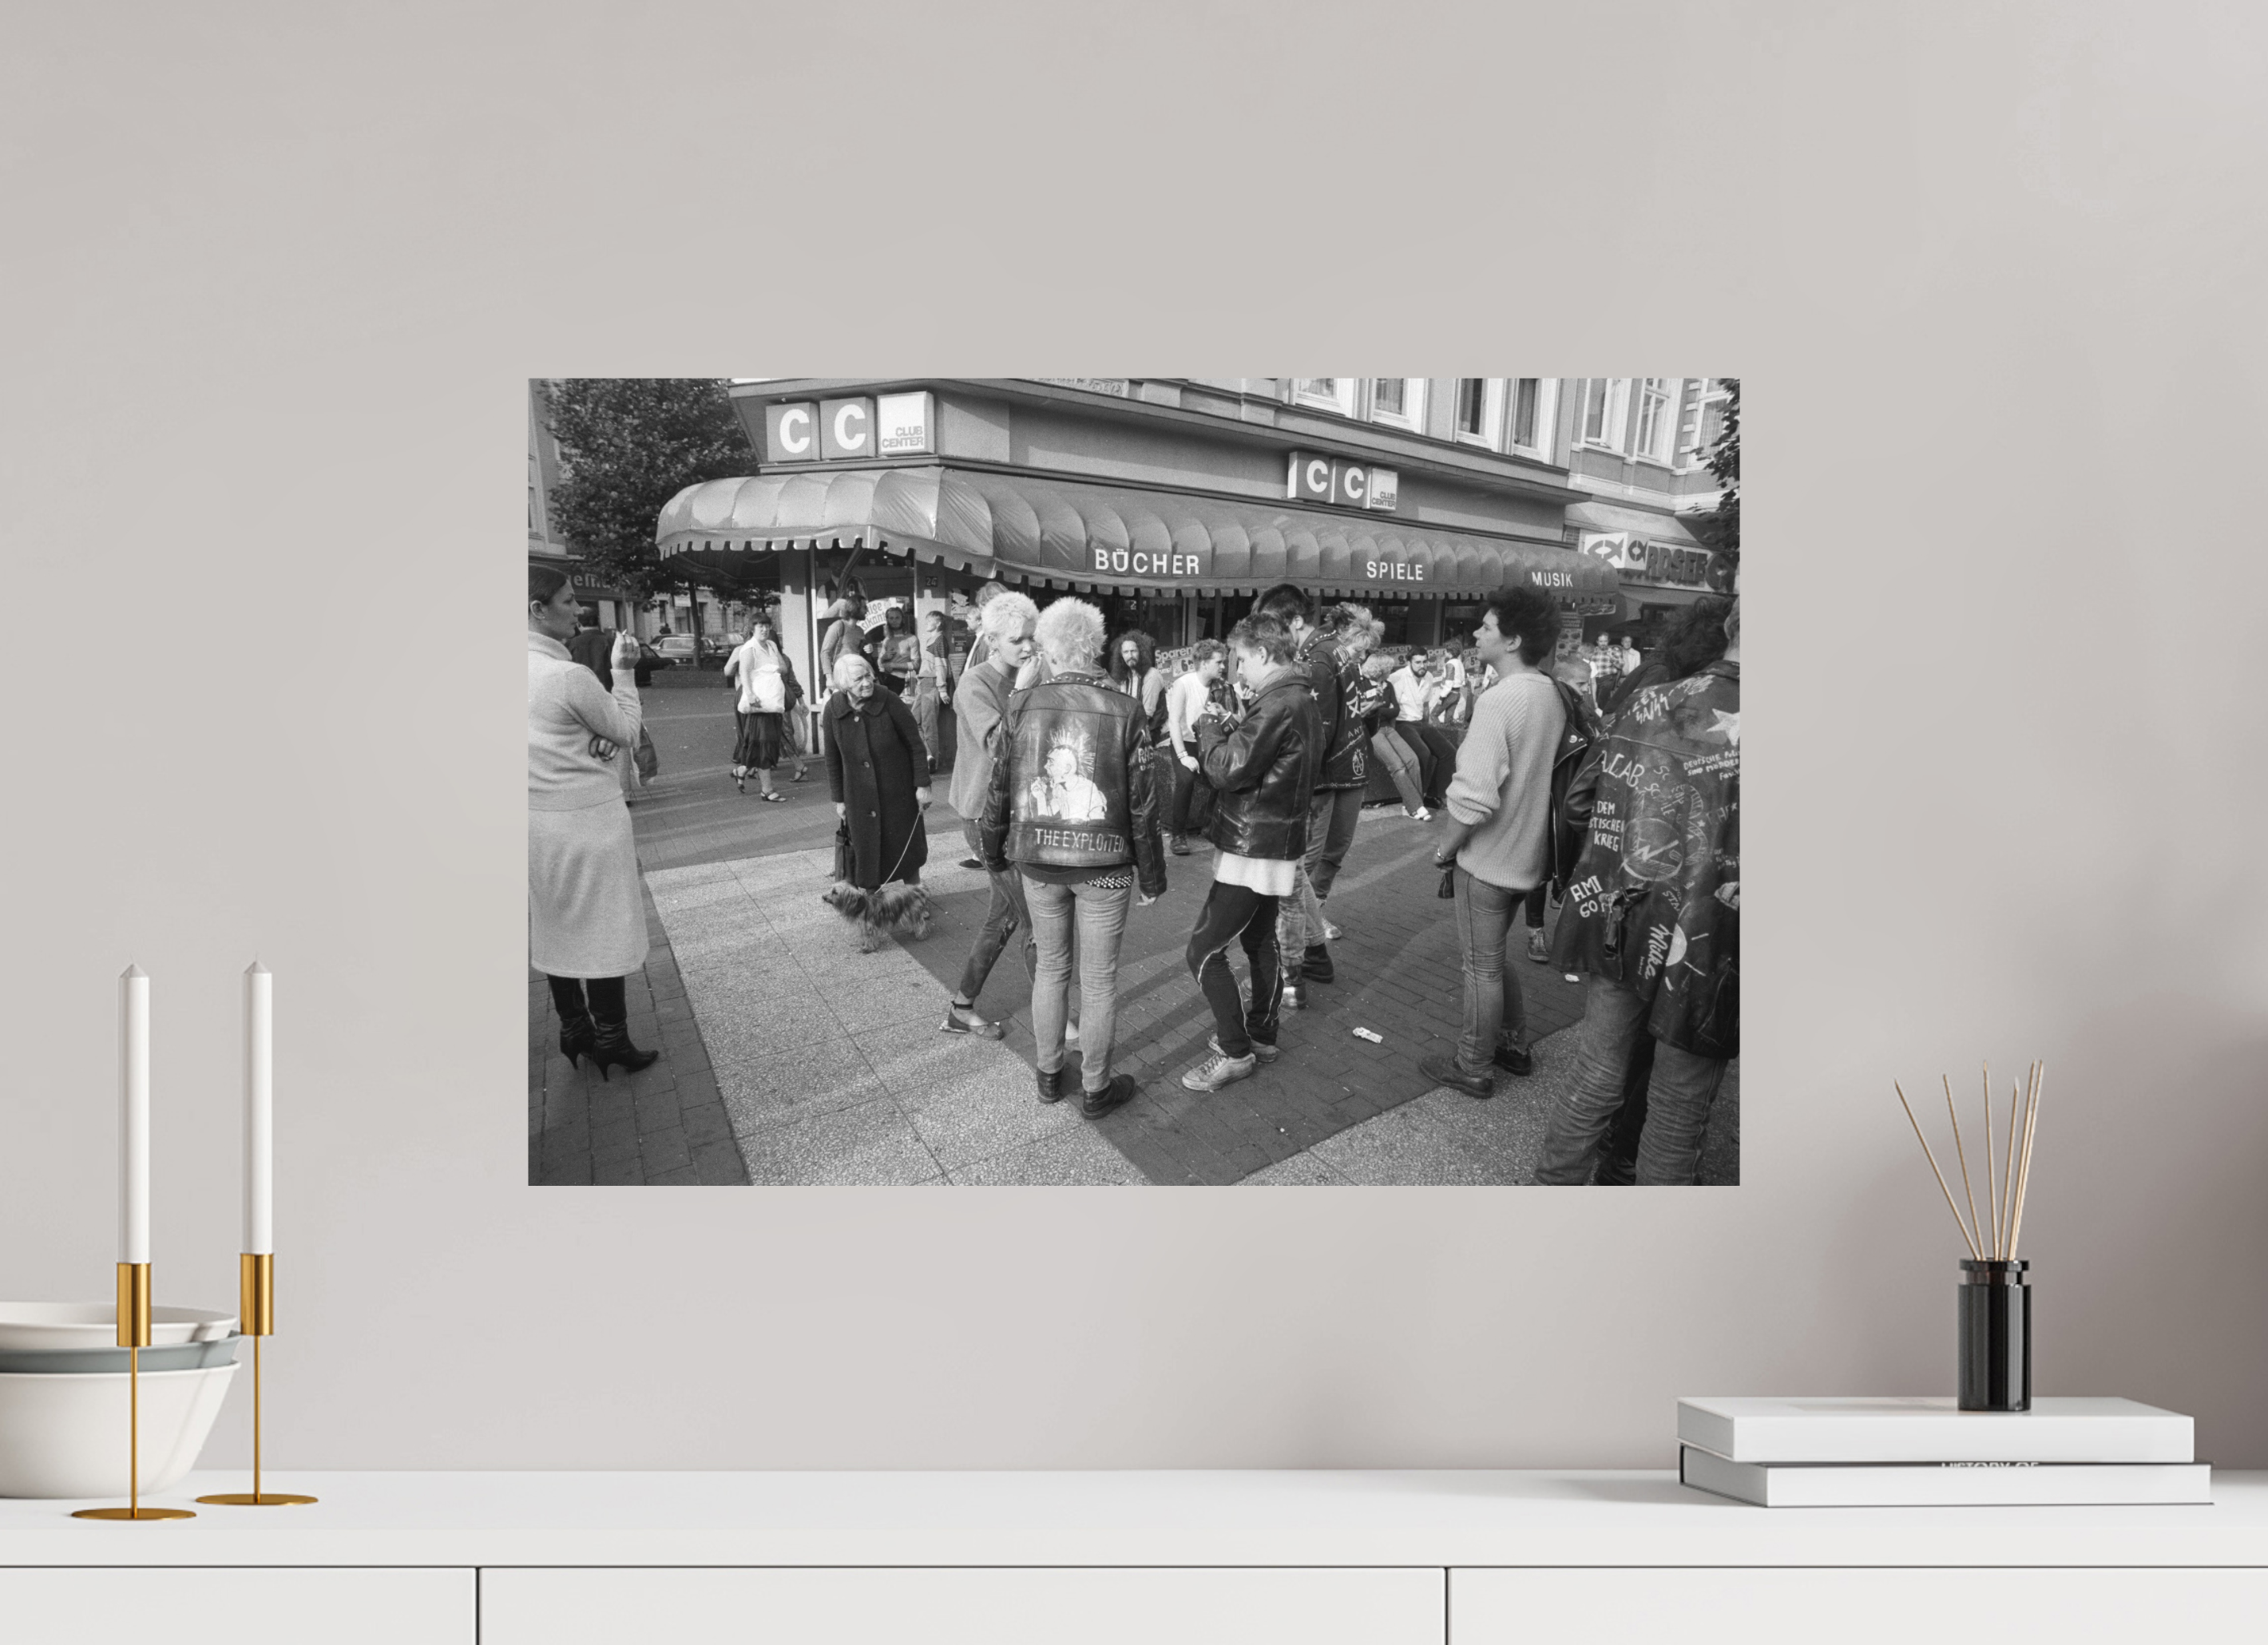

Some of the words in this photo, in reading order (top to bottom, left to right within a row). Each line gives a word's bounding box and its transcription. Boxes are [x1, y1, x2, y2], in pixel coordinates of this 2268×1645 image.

[779, 408, 811, 454] C
[835, 404, 866, 450] C
[895, 426, 923, 437] CLUB
[882, 436, 924, 449] CENTER
[1306, 459, 1329, 493] C
[1344, 466, 1365, 499] C
[1371, 497, 1396, 507] CENTER
[1380, 491, 1396, 500] CLUB
[1095, 548, 1199, 575] BÜCHER
[1366, 561, 1424, 581] SPIELE
[1532, 571, 1573, 587] MUSIK
[1155, 646, 1193, 663] Sparen
[1597, 800, 1616, 815] DEM
[1035, 828, 1060, 846] THE
[1594, 830, 1620, 852] KRIEG
[1570, 875, 1603, 902] AMI
[1580, 900, 1598, 918] GO
